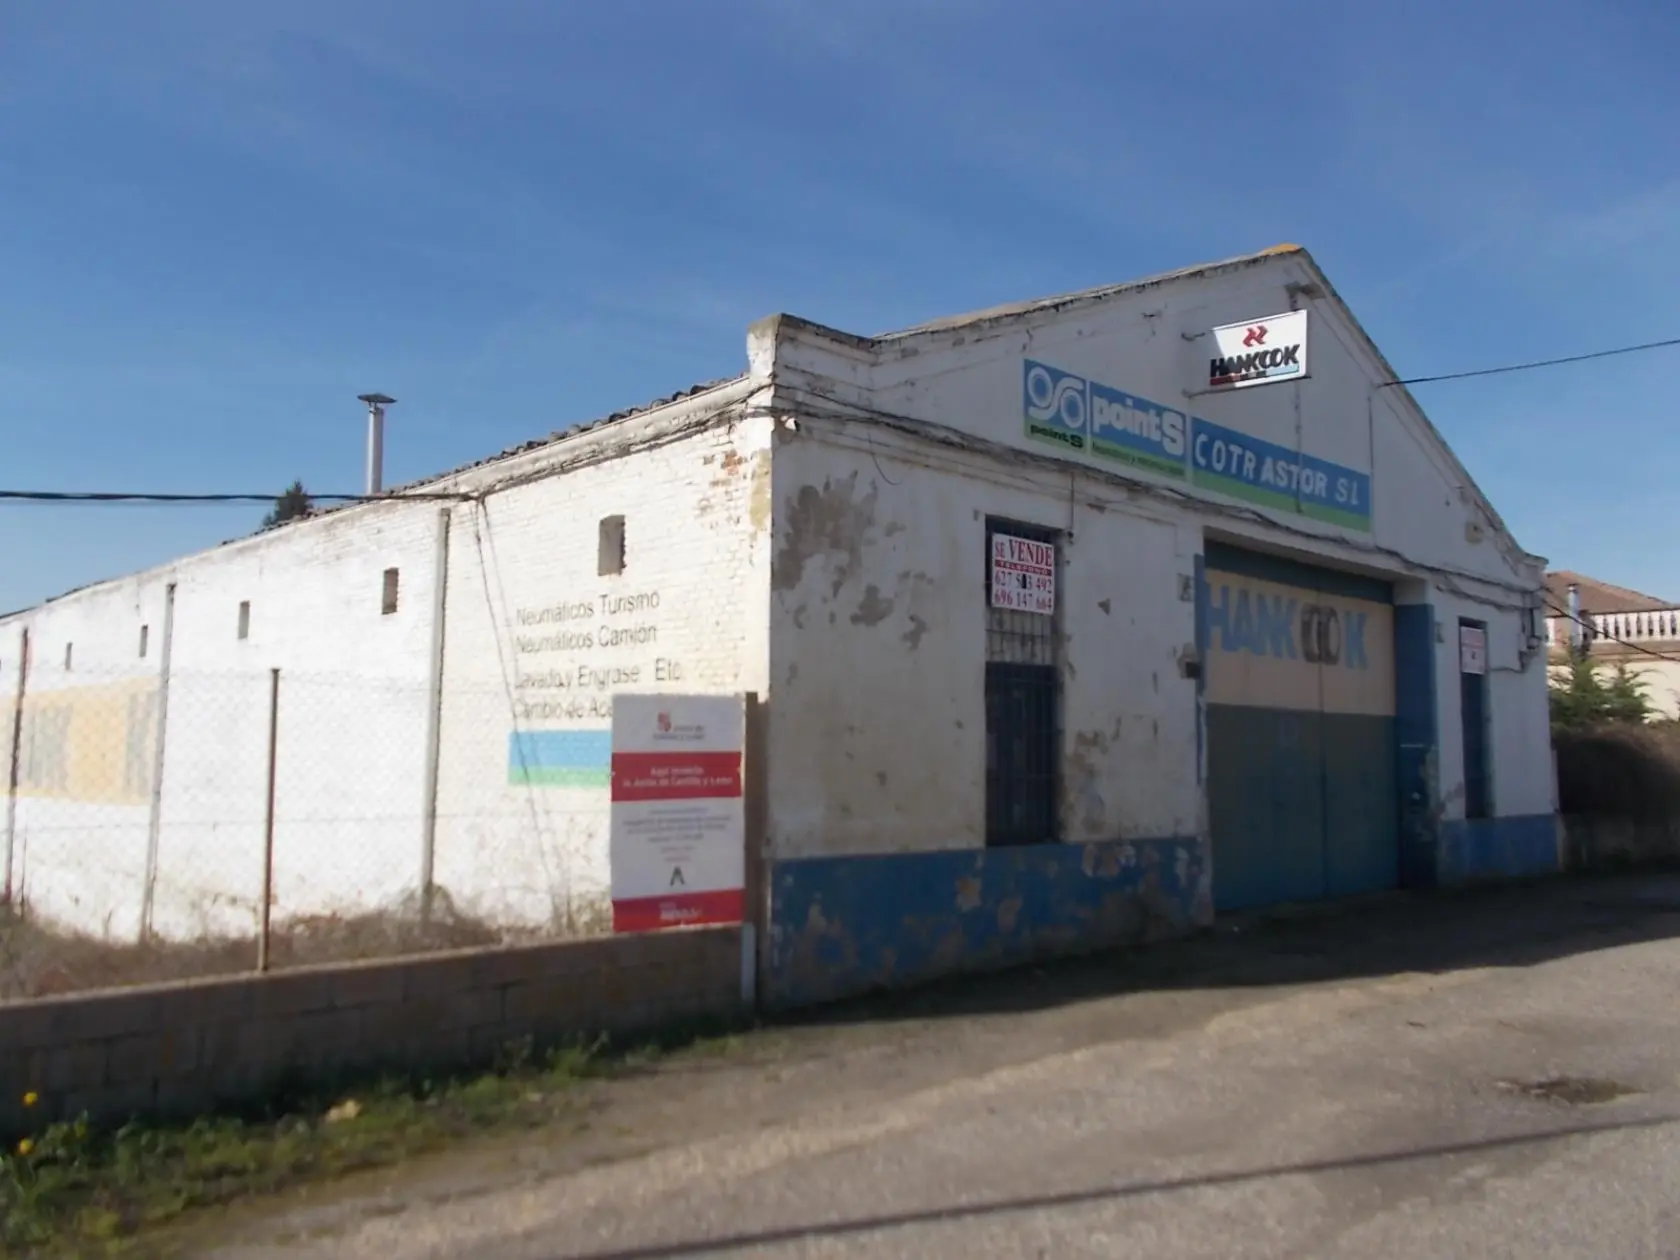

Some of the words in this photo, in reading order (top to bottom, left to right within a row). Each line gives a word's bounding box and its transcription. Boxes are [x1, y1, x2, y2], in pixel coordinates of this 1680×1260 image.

[995, 541, 1006, 559] SE
[1008, 538, 1053, 568] VENDE
[1015, 573, 1034, 590] 53
[598, 590, 661, 616] Turismo
[577, 663, 641, 691] Engrase
